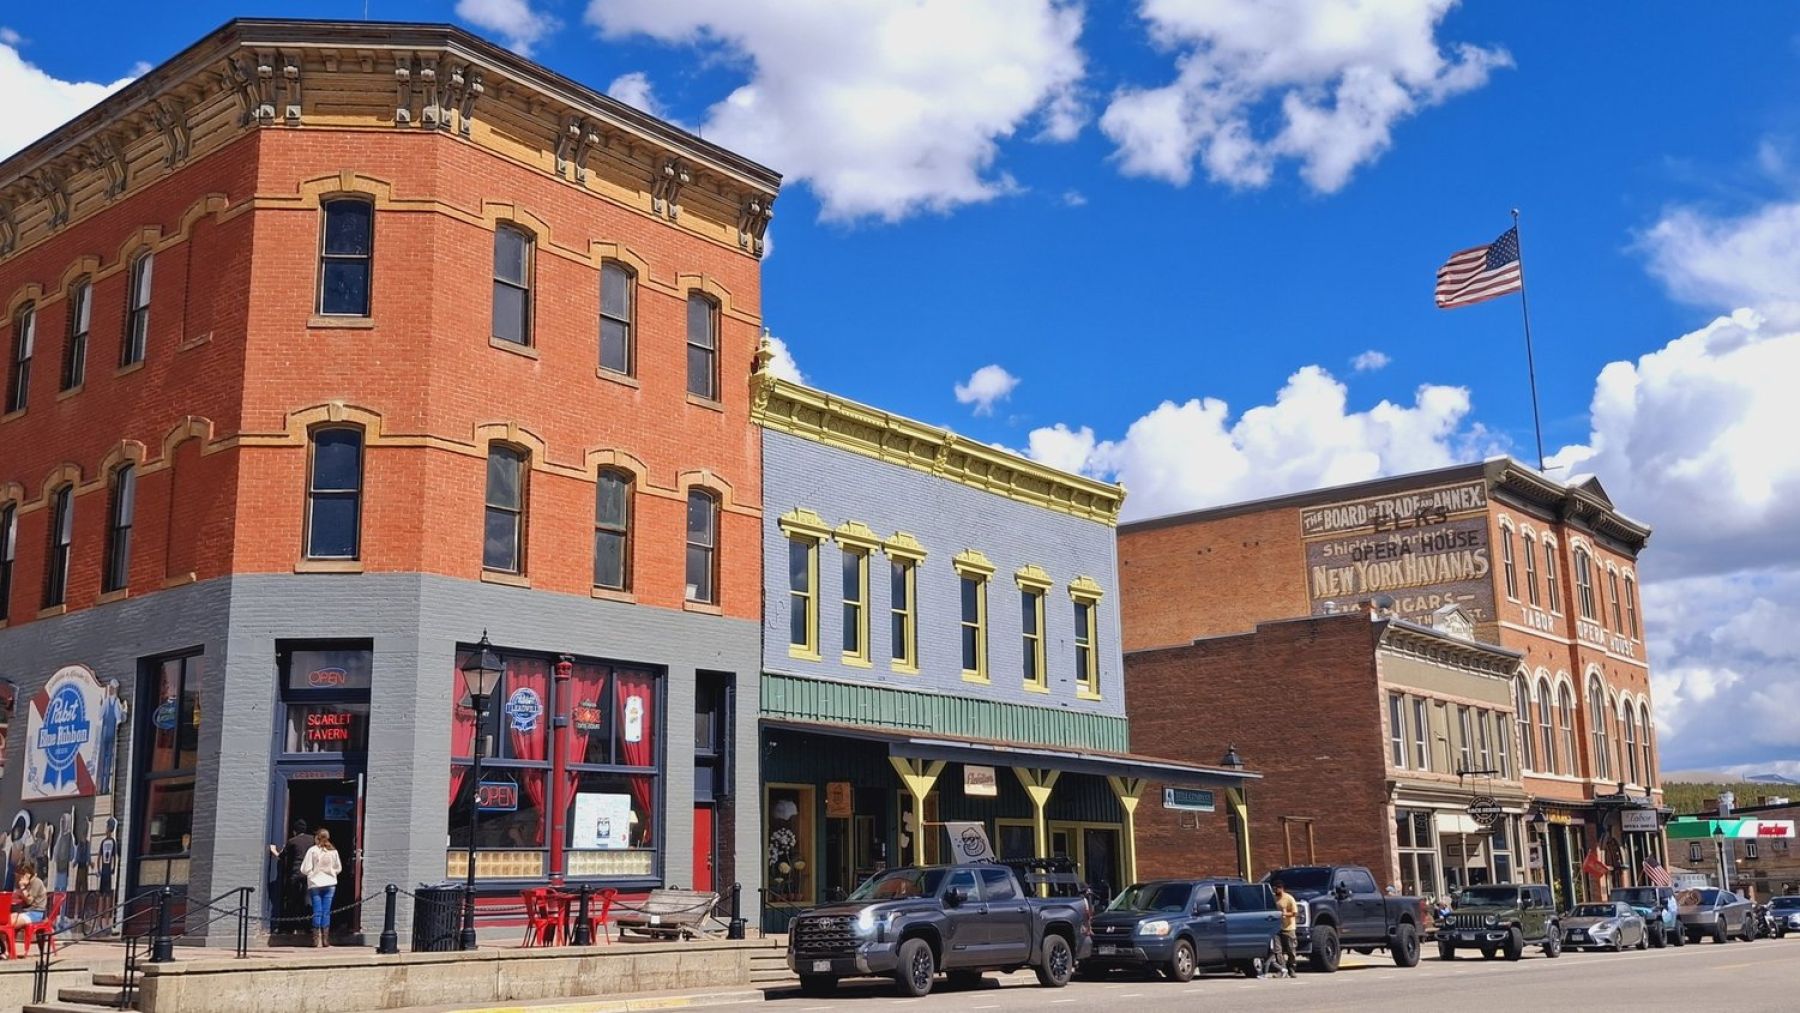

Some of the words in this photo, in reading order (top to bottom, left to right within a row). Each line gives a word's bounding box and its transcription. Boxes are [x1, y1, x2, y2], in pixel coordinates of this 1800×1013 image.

[1303, 512, 1324, 531] THE
[1324, 504, 1368, 530] BOARD
[1375, 493, 1421, 519] TRADE
[1433, 485, 1486, 510] ANNEX.
[1374, 506, 1450, 533] ELKS
[1351, 540, 1412, 562] OPERA
[1312, 566, 1355, 599] NEW
[1353, 560, 1405, 593] YORK
[1404, 548, 1489, 584] HAVANAS
[1394, 592, 1454, 613] IGARS
[1522, 607, 1554, 633] TABOR
[1577, 620, 1605, 643] OPERA
[1610, 636, 1635, 658] HOUSE
[308, 670, 346, 684] OPEN
[50, 696, 79, 724] Pabst
[307, 713, 352, 726] SCARLET
[39, 728, 57, 748] Blue
[56, 725, 88, 745] Ribbon
[307, 728, 348, 741] TAVERN
[478, 786, 516, 807] OPEN
